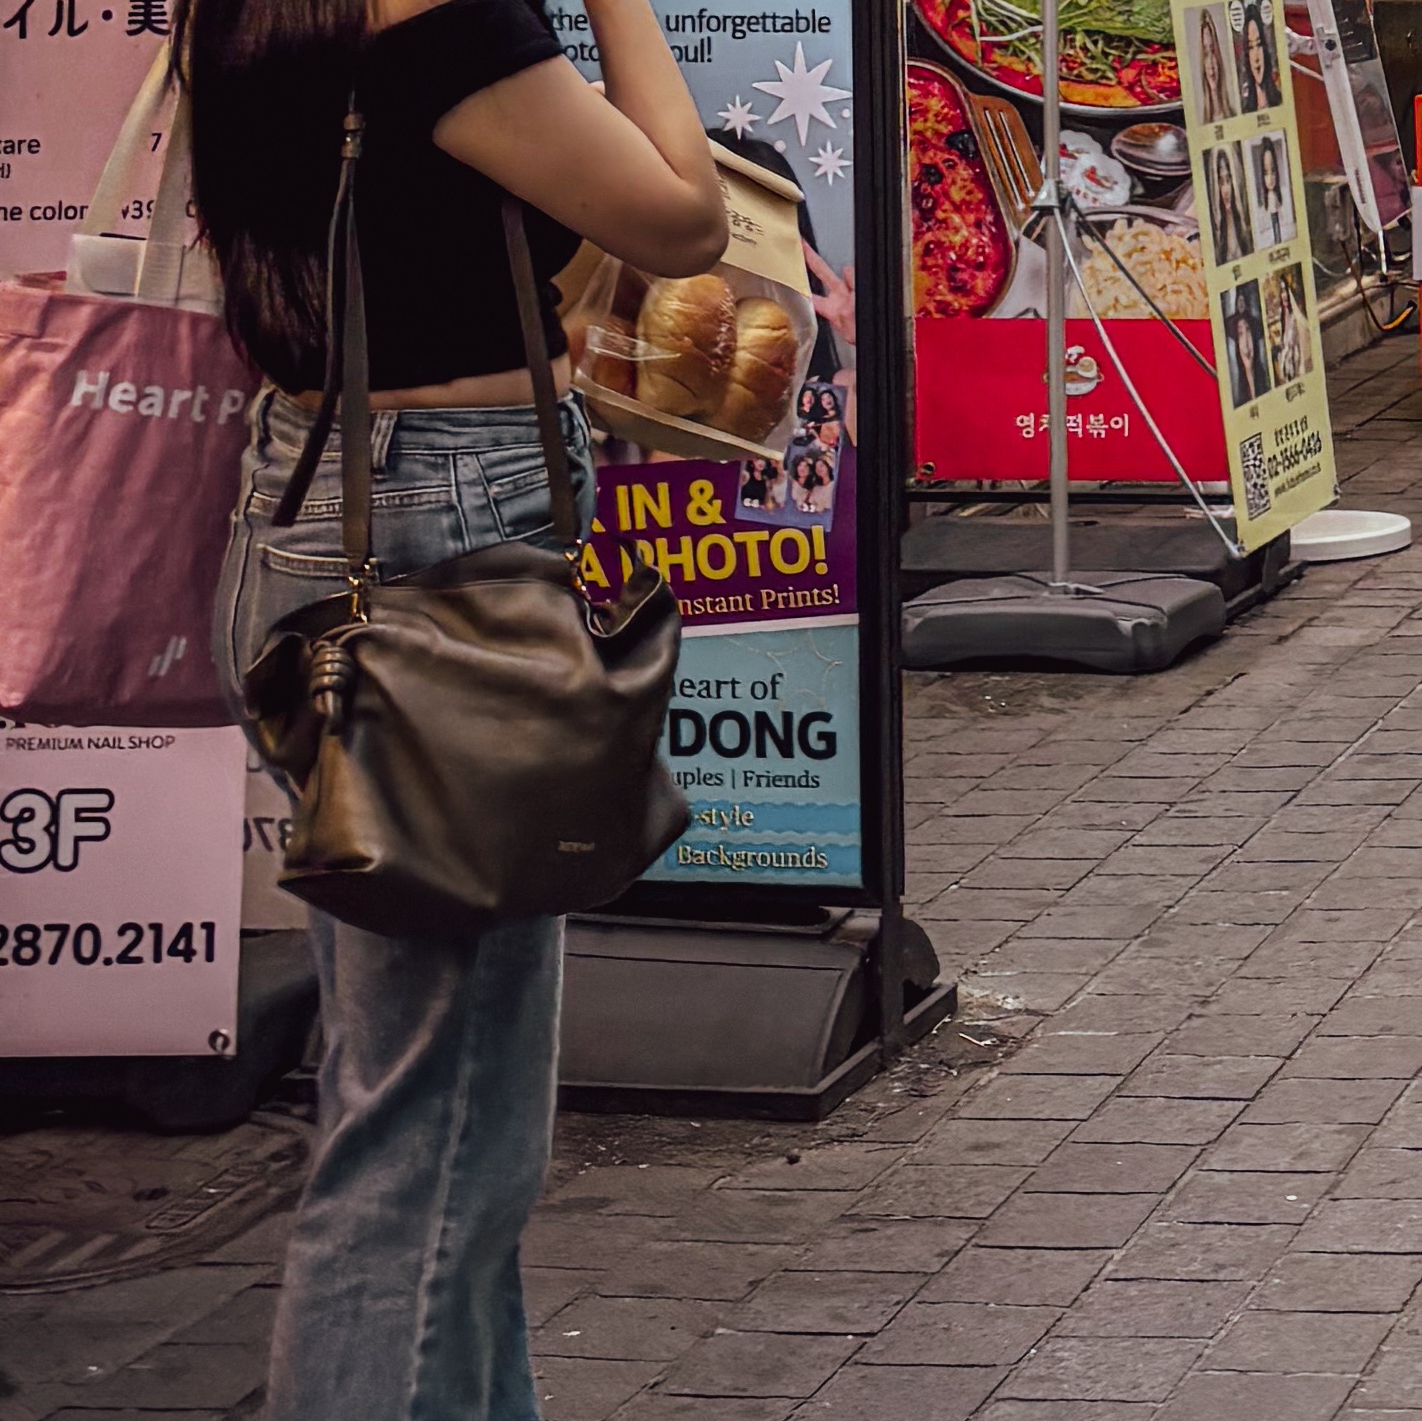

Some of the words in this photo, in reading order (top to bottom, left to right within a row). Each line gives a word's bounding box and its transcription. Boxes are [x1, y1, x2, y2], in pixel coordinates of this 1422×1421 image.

[666, 9, 831, 39] unforgettable
[30, 200, 89, 221] color
[71, 369, 210, 423] Heart
[616, 482, 672, 531] IN
[686, 479, 727, 526] &
[760, 583, 841, 610] Prints!
[750, 672, 784, 700] of
[6, 736, 83, 750] PREMIUM
[87, 736, 125, 749] NAIL
[128, 735, 176, 750] SHOP
[668, 708, 838, 761] DONG
[743, 769, 820, 789] Friends
[0, 788, 115, 873] 3F
[677, 843, 829, 871] Backgrounds
